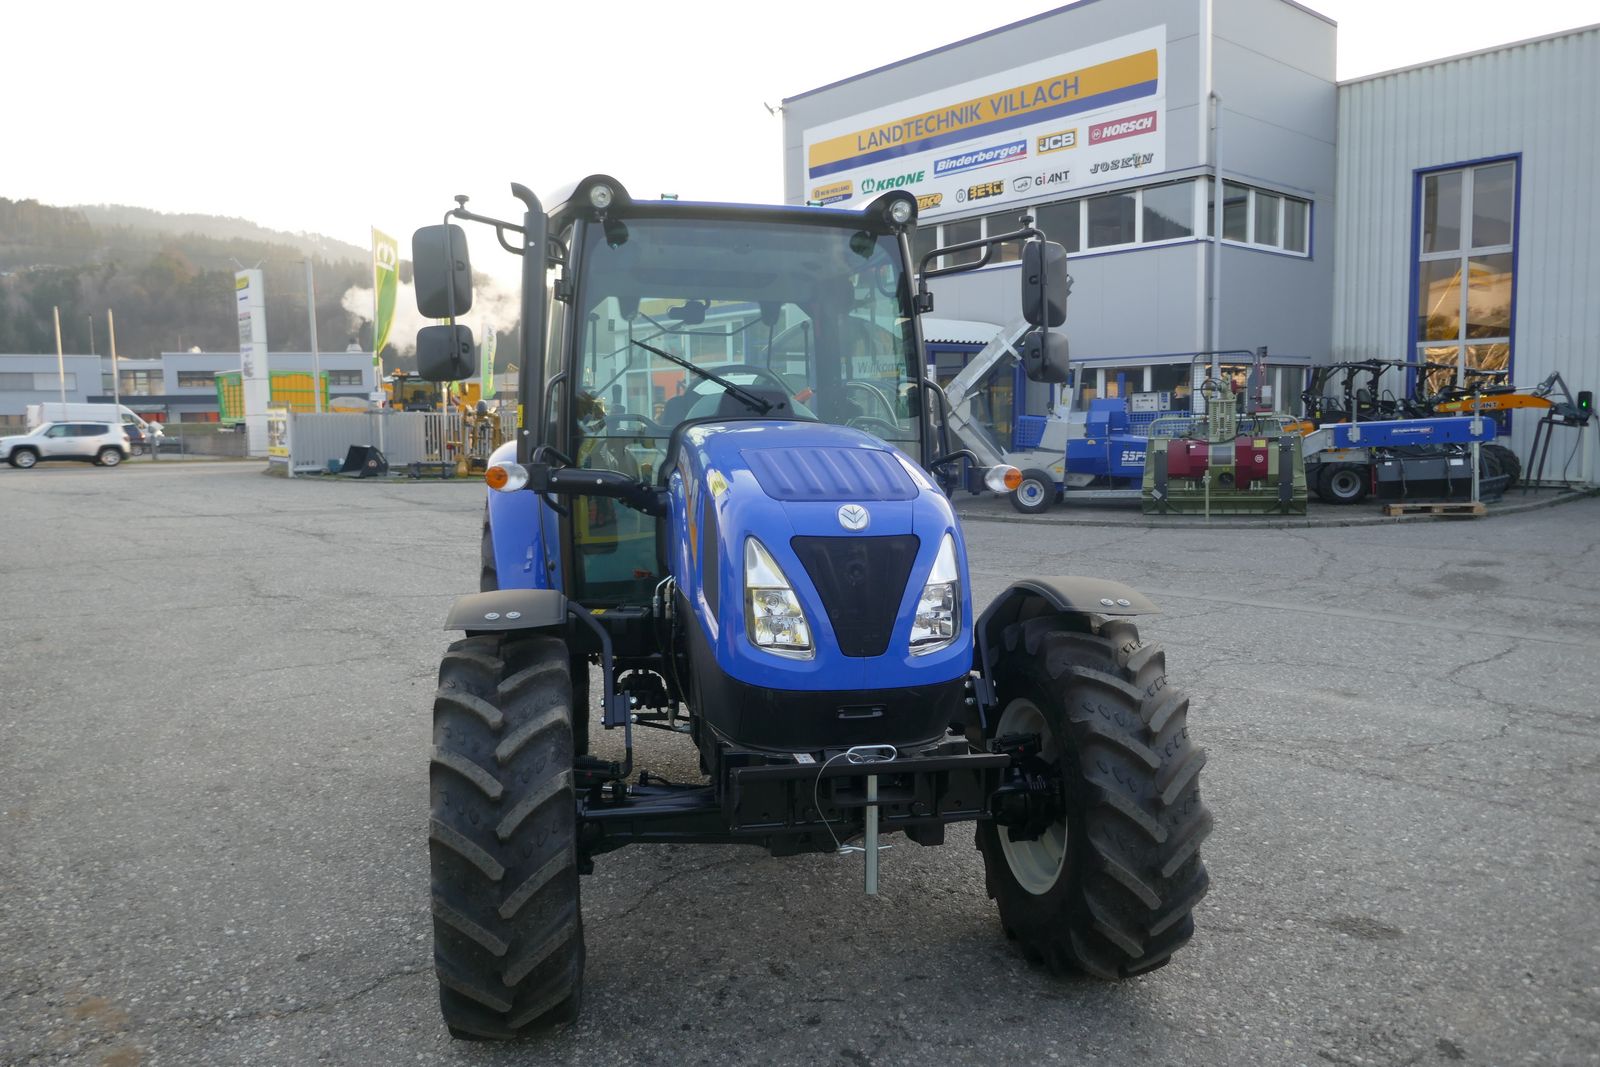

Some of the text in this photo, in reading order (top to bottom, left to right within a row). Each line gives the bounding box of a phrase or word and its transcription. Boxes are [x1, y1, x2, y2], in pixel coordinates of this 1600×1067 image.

[858, 76, 1079, 151] LANDTECHNIK VILLACH
[1101, 116, 1153, 138] HORSCH
[1039, 133, 1076, 153] JCB
[936, 143, 1025, 171] Binderberger
[1089, 153, 1154, 174] JOSKIN
[876, 170, 925, 191] KRONE
